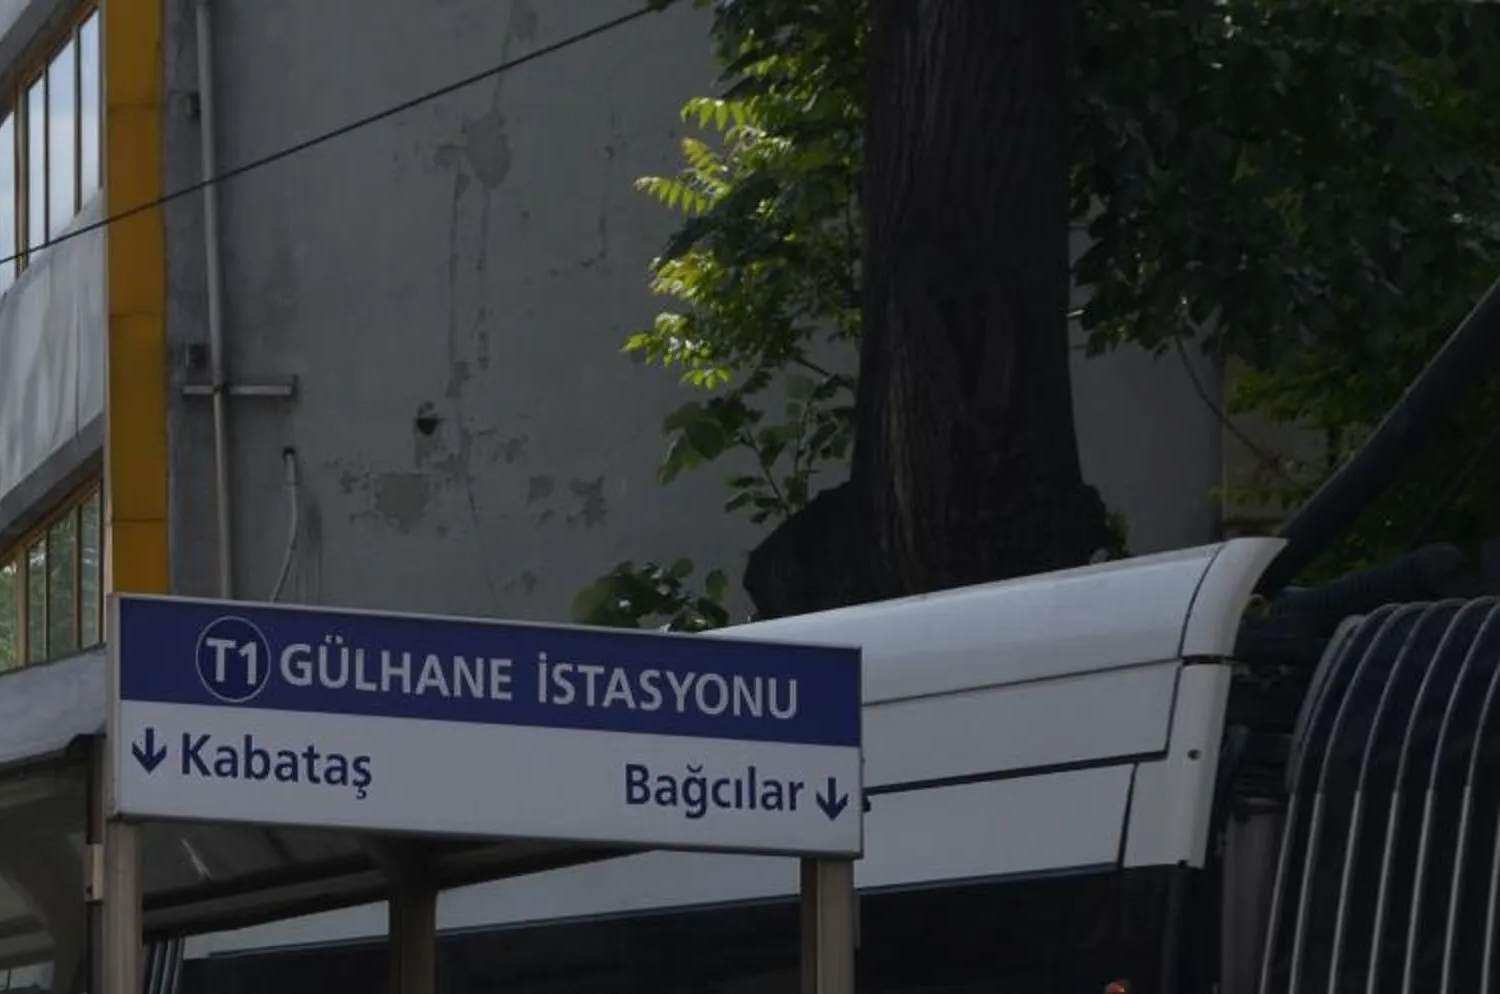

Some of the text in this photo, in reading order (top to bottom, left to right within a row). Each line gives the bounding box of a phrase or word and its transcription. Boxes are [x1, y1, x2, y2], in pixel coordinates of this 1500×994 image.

[206, 635, 798, 720] T1 GÜLHANE İSTASYONU
[181, 732, 373, 799] Kabataş
[625, 763, 805, 819] Bağcılar
